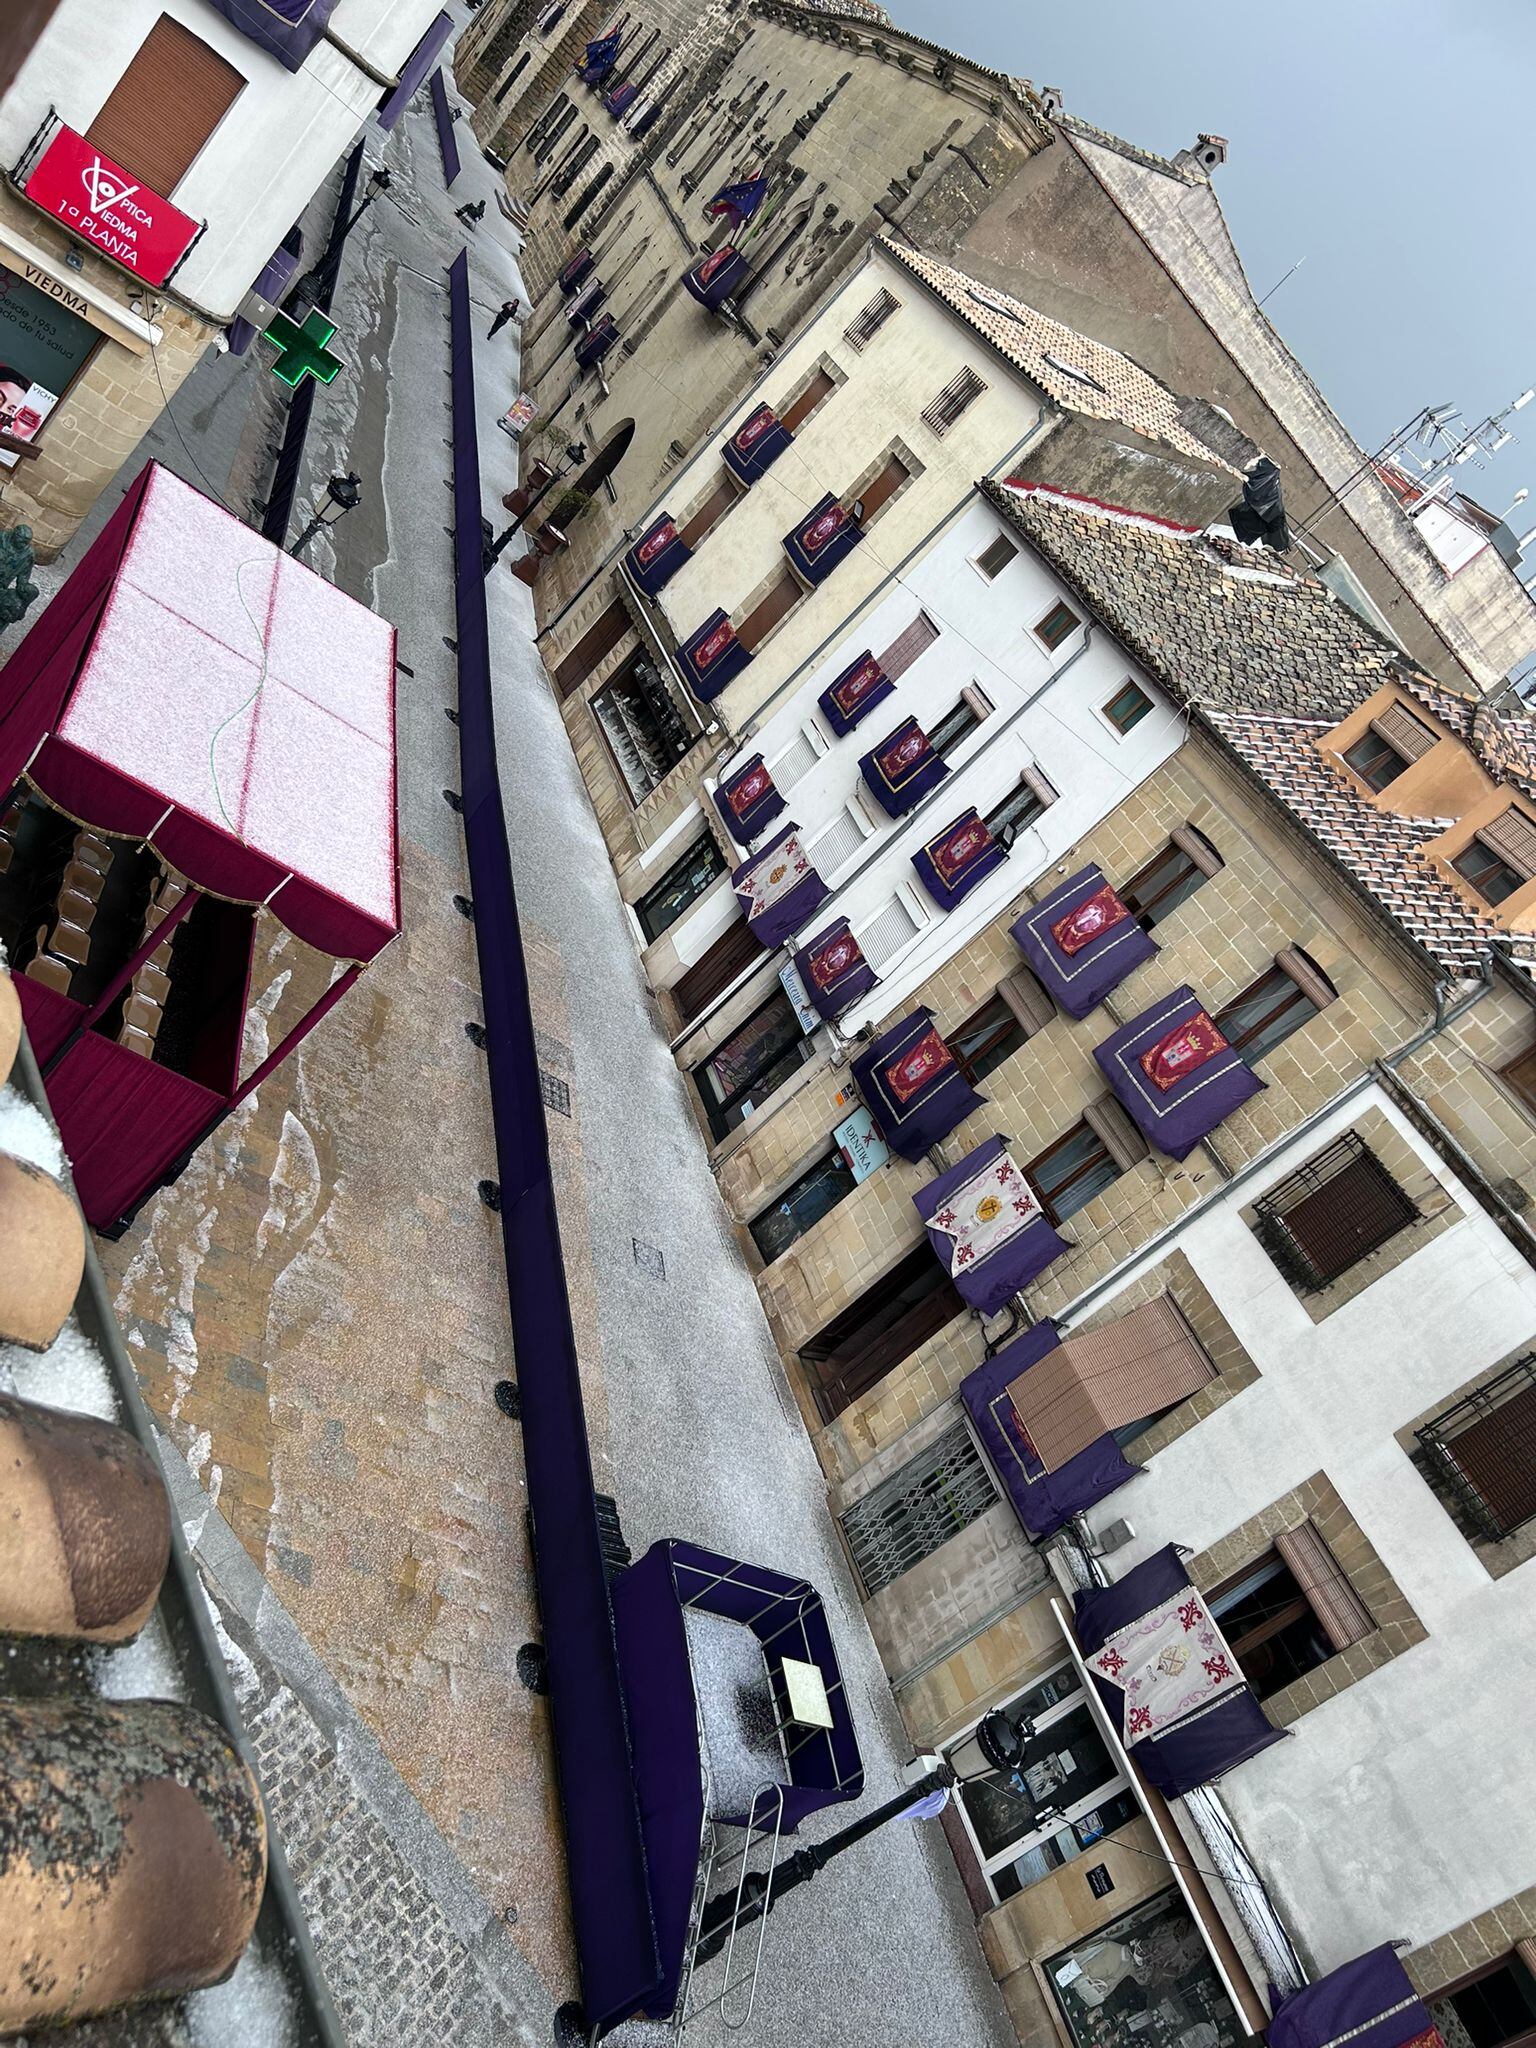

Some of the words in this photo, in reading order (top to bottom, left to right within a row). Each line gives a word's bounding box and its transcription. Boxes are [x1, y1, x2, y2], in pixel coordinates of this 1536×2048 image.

[79, 215, 138, 266] PLANTA
[25, 265, 89, 316] VIEDMA
[18, 320, 34, 333] de
[34, 330, 46, 341] tu
[46, 339, 75, 360] salud
[32, 315, 57, 336] 1953
[32, 385, 56, 403] VICHY
[845, 1124, 872, 1171] IDENTIKA
